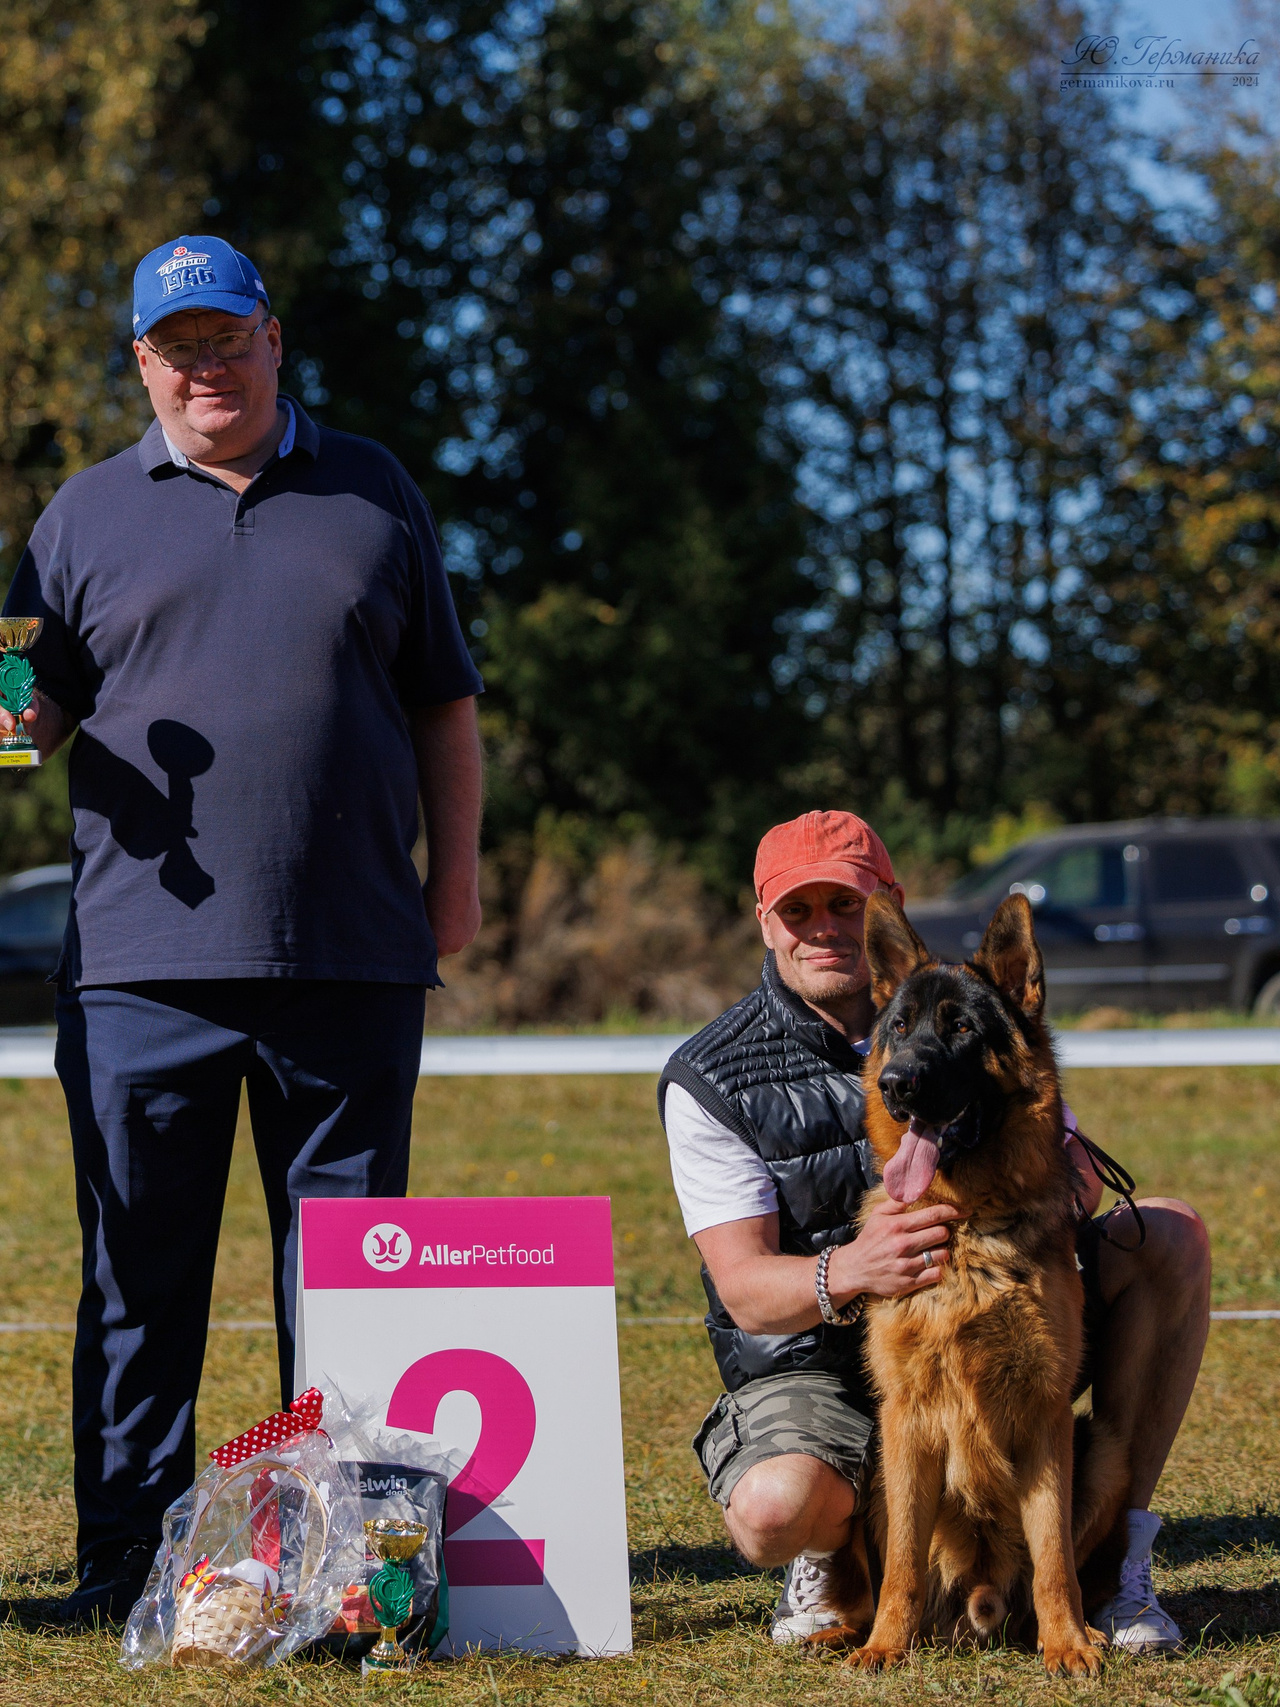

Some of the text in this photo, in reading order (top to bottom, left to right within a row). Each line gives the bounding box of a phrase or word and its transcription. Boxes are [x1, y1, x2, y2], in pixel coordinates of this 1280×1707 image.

[162, 266, 216, 296] 1946
[418, 1243, 555, 1266] AllerPetfood
[385, 1348, 546, 1586] 2
